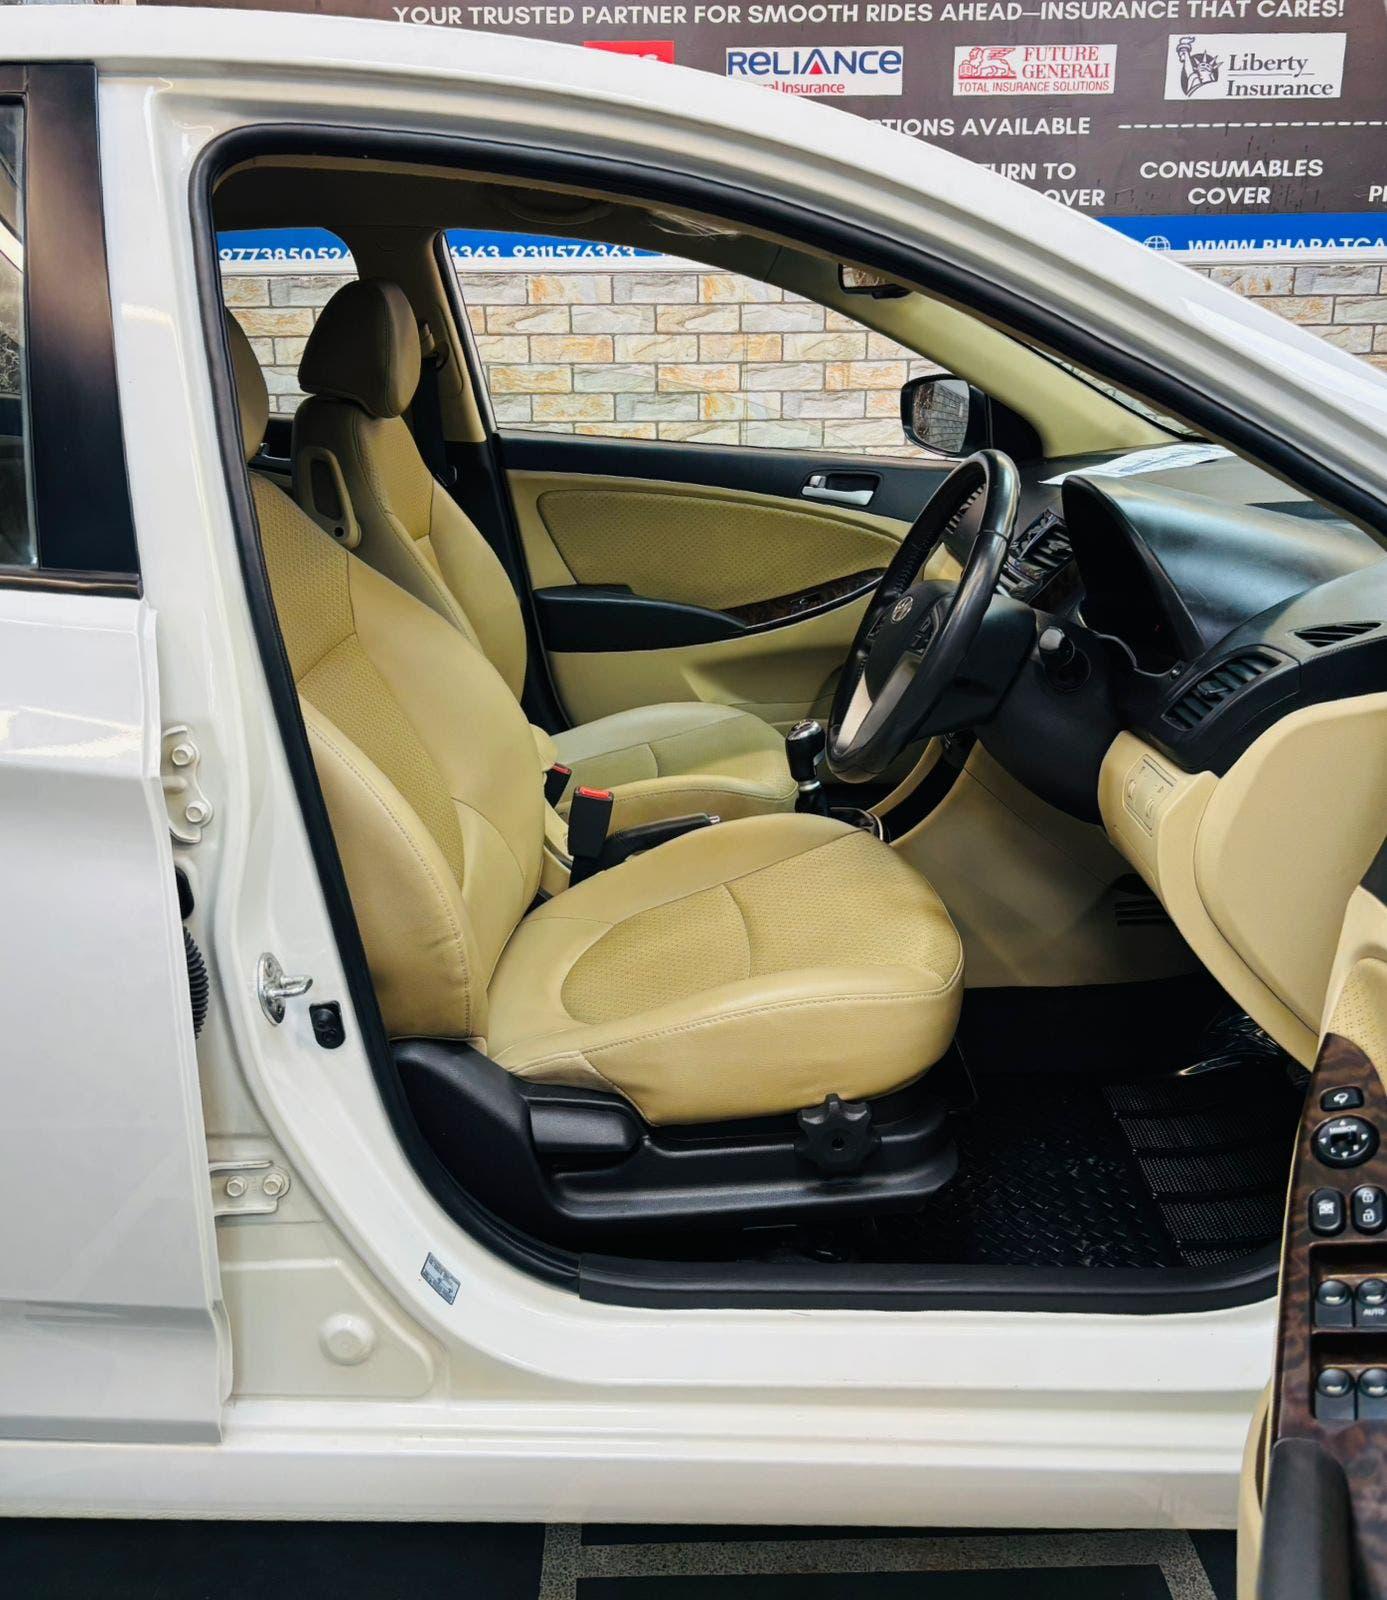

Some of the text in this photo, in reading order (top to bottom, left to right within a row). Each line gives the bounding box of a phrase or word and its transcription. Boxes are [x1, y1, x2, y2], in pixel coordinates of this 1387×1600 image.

[393, 6, 462, 24] YOUR
[468, 6, 574, 24] TRUSTED
[582, 5, 687, 24] PARTNER
[694, 5, 742, 23] FOR
[748, 4, 859, 23] SMOOTH
[866, 3, 933, 22] RIDES
[1186, 0, 1248, 18] THAT
[1257, 0, 1345, 18] CARES!
[1024, 46, 1099, 62] FUTURE
[1022, 63, 1110, 80] GENERALI
[1228, 53, 1308, 78] Liberty
[782, 82, 845, 94] Insurance
[959, 80, 1110, 93] TOTAL INSURANCE SOLUTIONS
[1226, 80, 1334, 97] Insurance
[960, 117, 1091, 136] AVAILABLE
[1043, 162, 1076, 180] TO
[1139, 159, 1324, 179] CONSUMABLES
[1187, 187, 1271, 205] COVER
